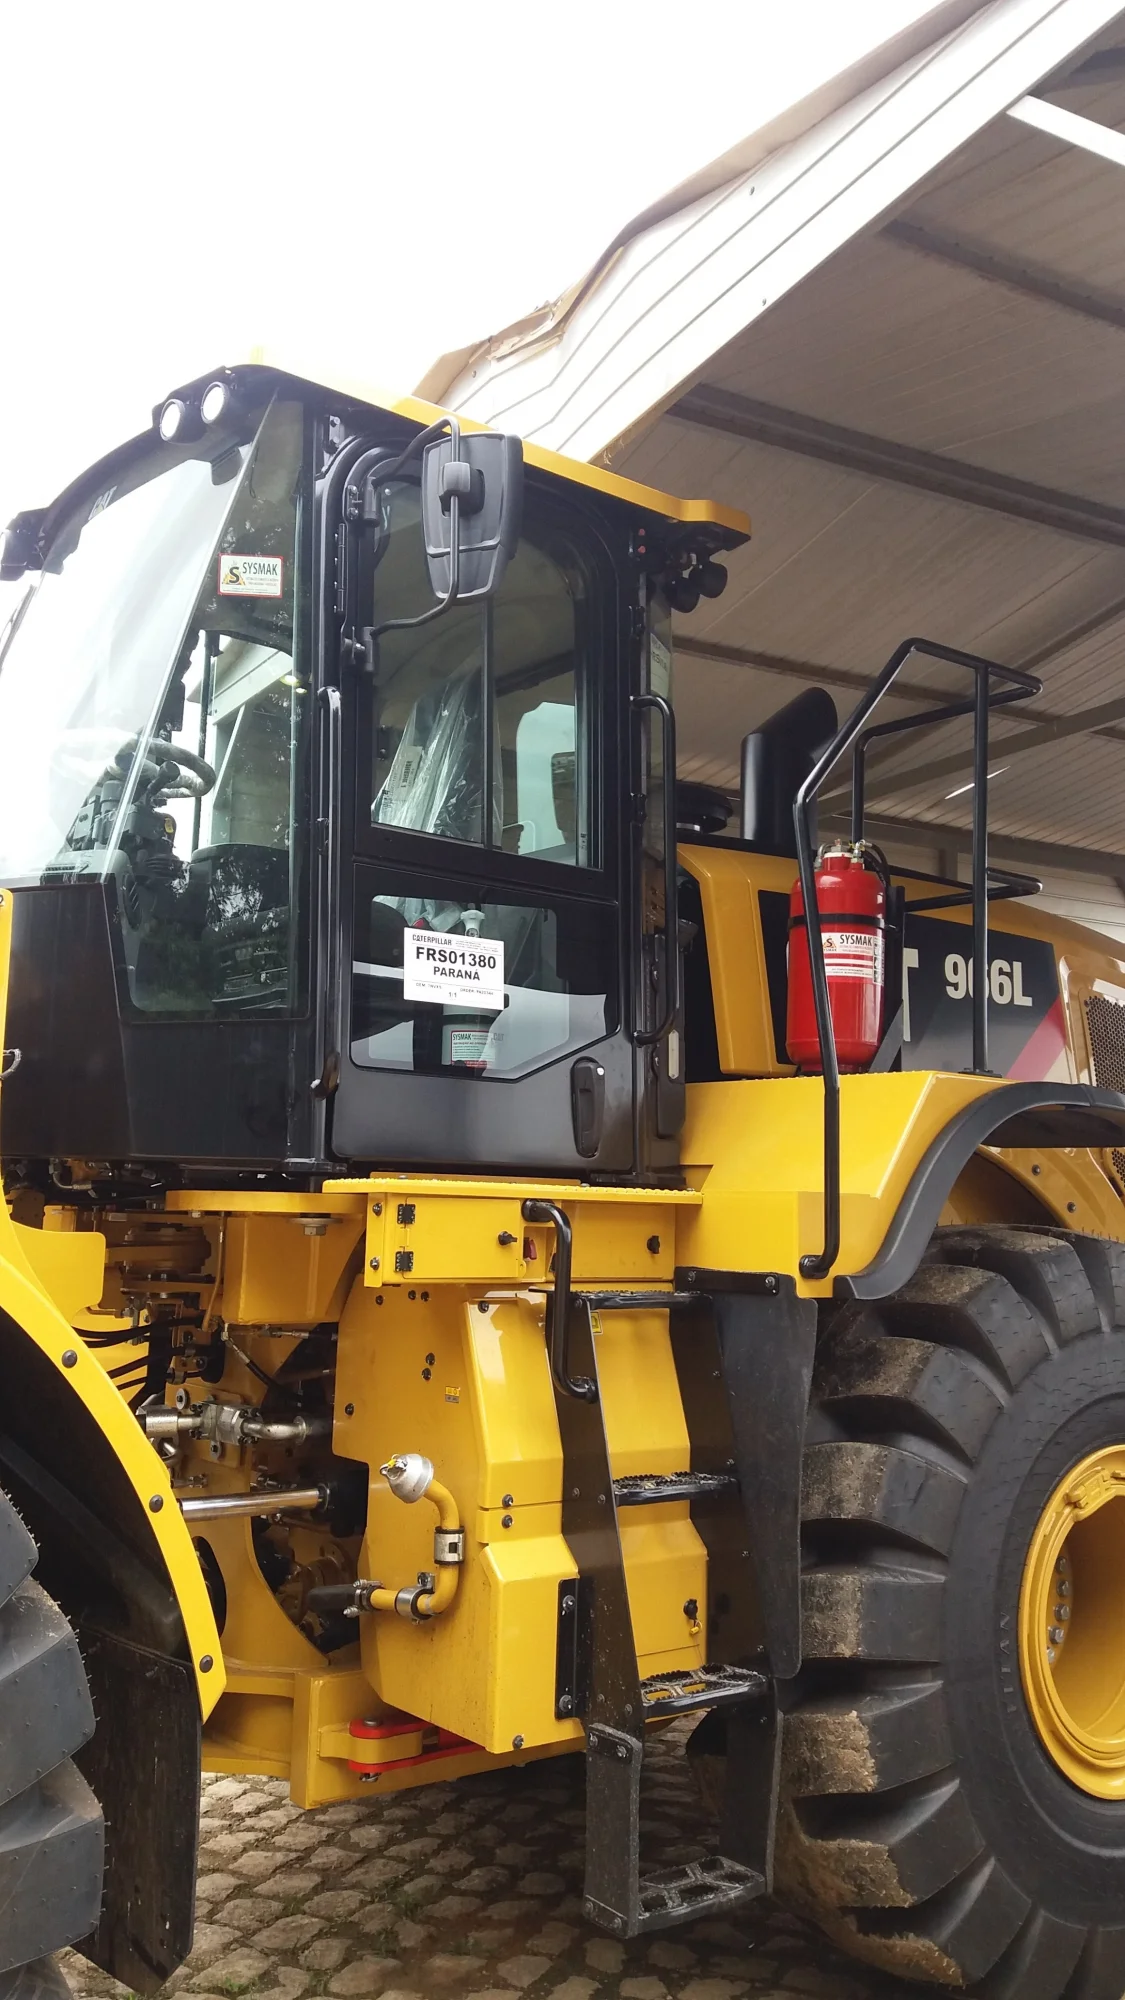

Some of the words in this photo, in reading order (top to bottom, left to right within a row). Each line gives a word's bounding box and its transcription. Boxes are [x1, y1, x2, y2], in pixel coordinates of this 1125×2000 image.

[242, 562, 278, 577] SYSMAK
[412, 934, 452, 946] CATERPILLAR
[839, 934, 873, 947] SYSMAK
[416, 946, 496, 969] FRS01380
[433, 966, 480, 981] PARANÁ
[453, 1033, 472, 1041] SYSMAK
